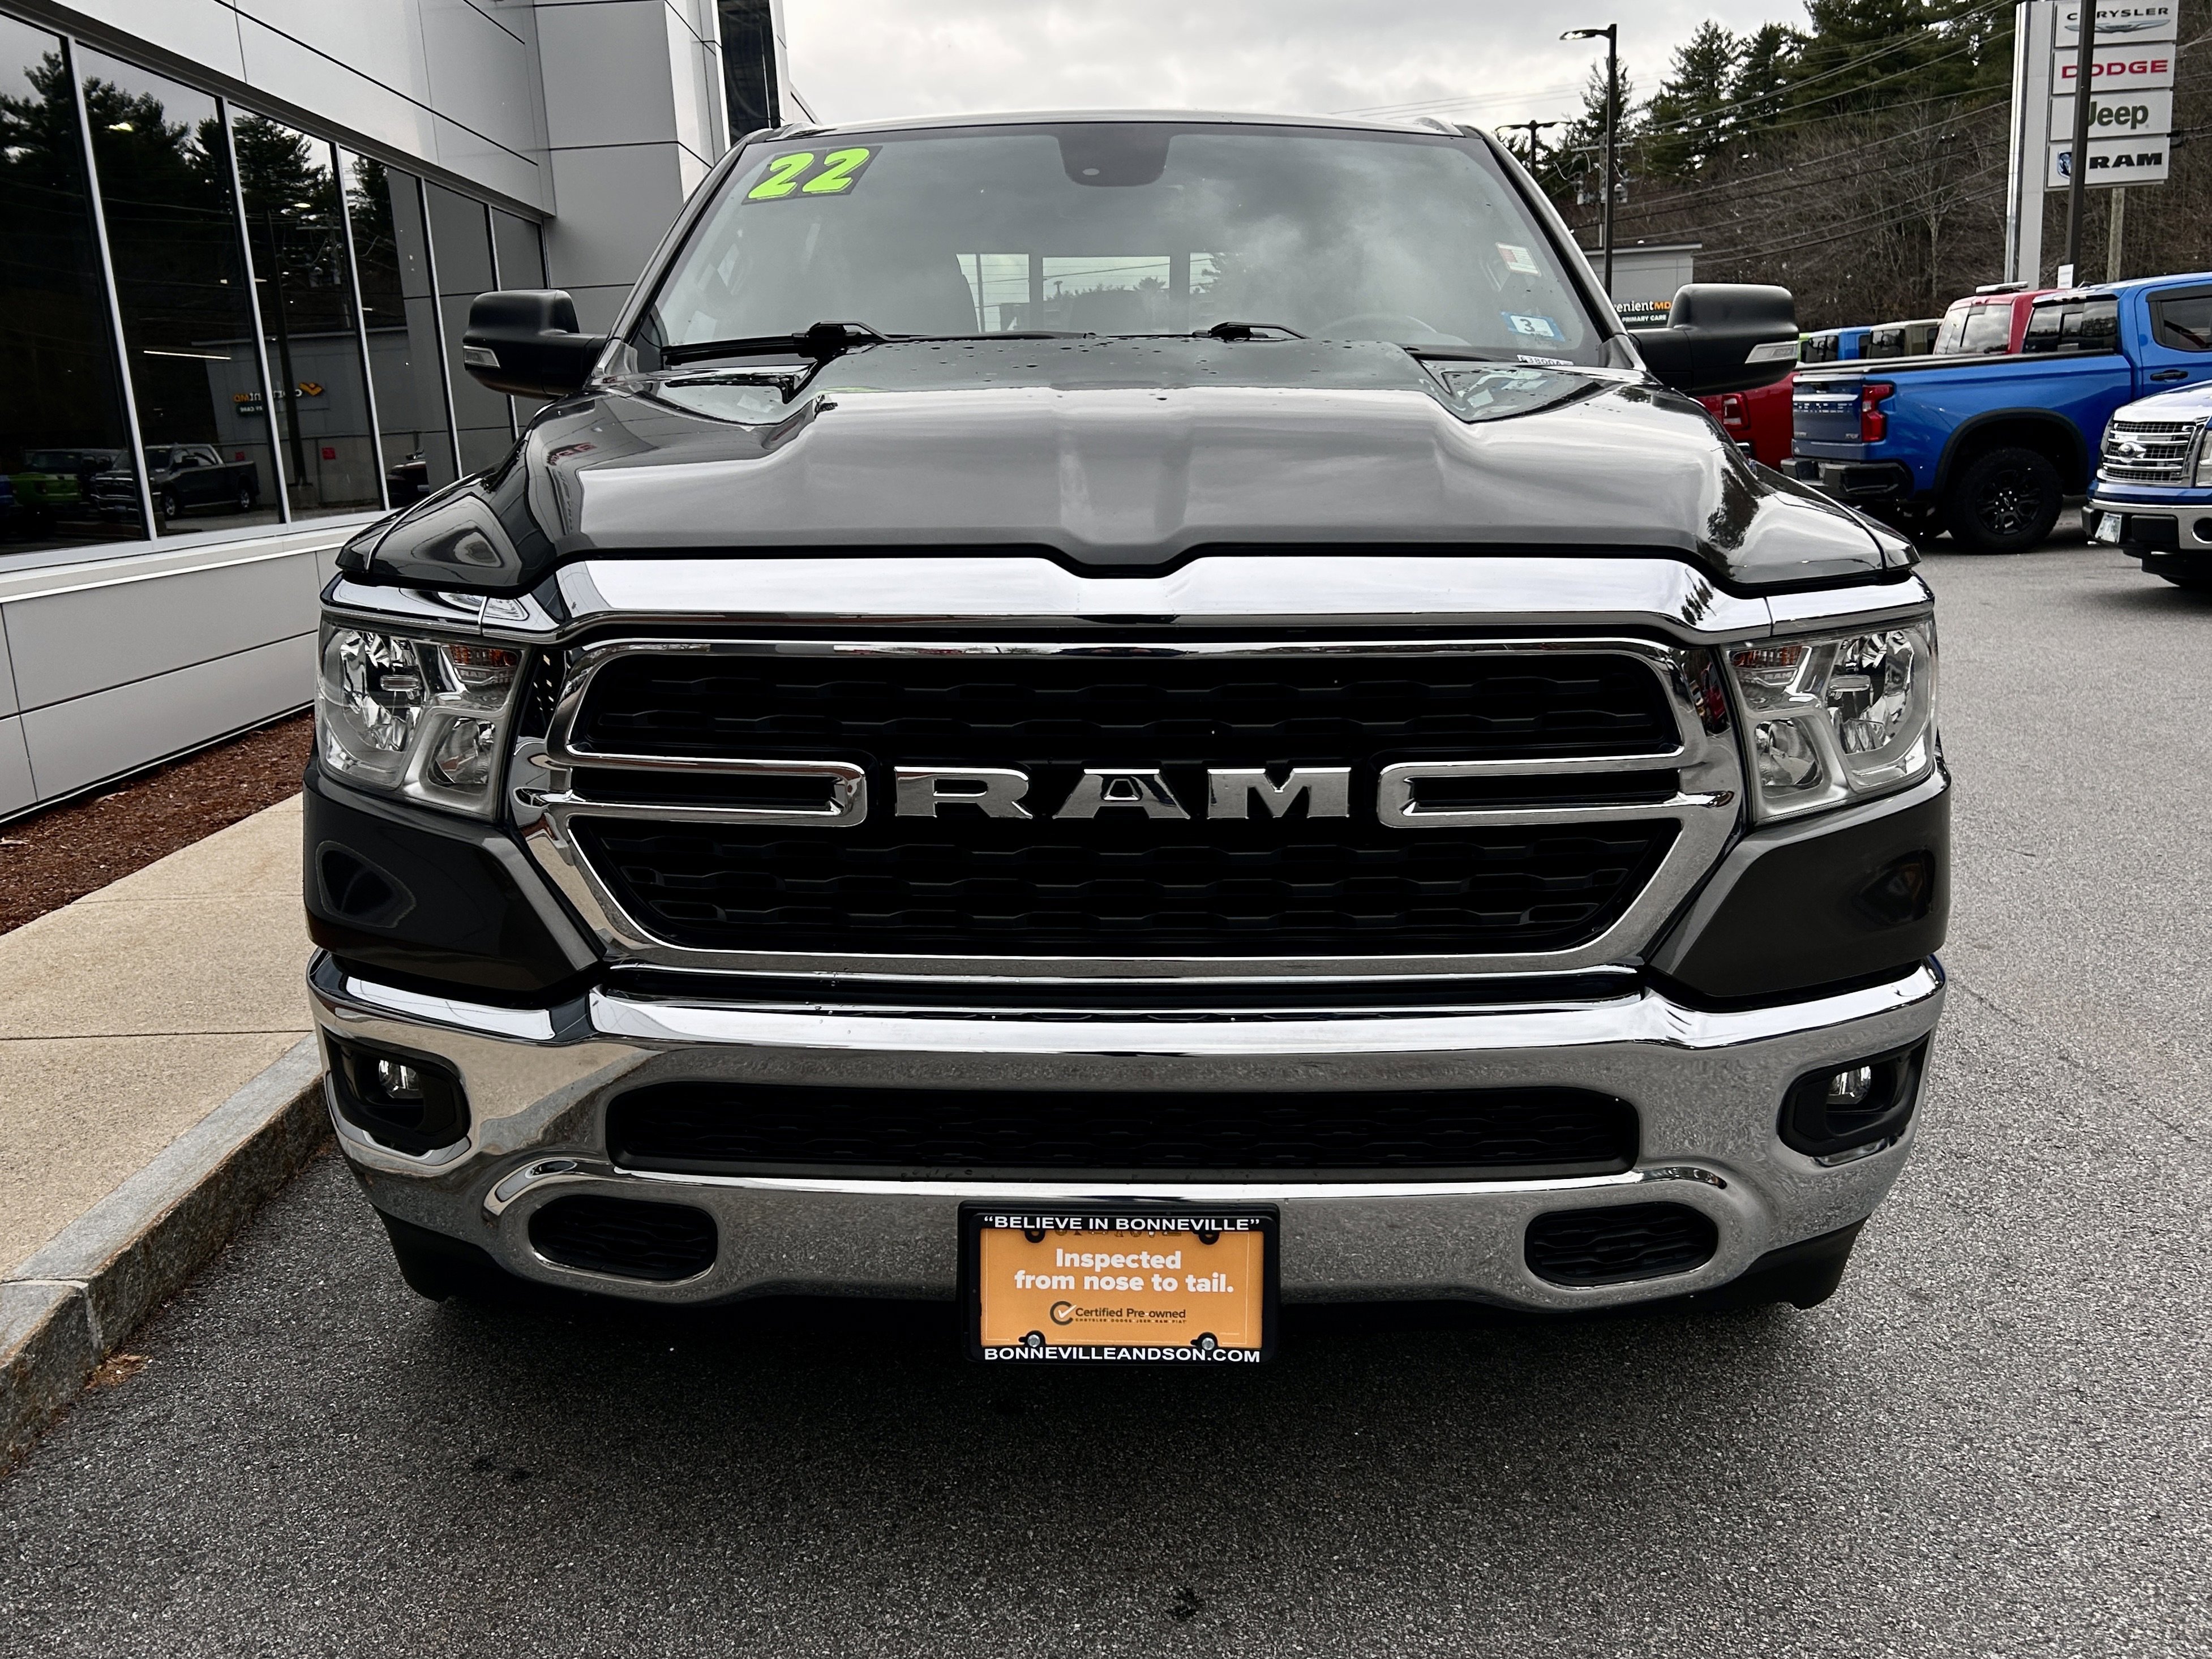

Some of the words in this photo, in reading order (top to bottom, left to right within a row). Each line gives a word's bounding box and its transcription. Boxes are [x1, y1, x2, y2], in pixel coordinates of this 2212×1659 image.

[2067, 7, 2168, 20] CRYSLER
[2061, 59, 2168, 79] DODGE
[2087, 101, 2149, 130] Jeep
[2089, 152, 2162, 169] RAM
[748, 148, 870, 200] 22
[1520, 319, 1535, 332] 3
[894, 766, 1352, 819] RAM
[1088, 1218, 1108, 1230] IN
[1056, 1248, 1181, 1272] Inspected
[1014, 1270, 1075, 1289] from
[1084, 1274, 1144, 1291] nose
[1152, 1275, 1178, 1292] to
[1186, 1272, 1234, 1293] tail.
[1075, 1308, 1122, 1317] Certified
[985, 1348, 1260, 1362] BONNEVILLEANDSON.COM
